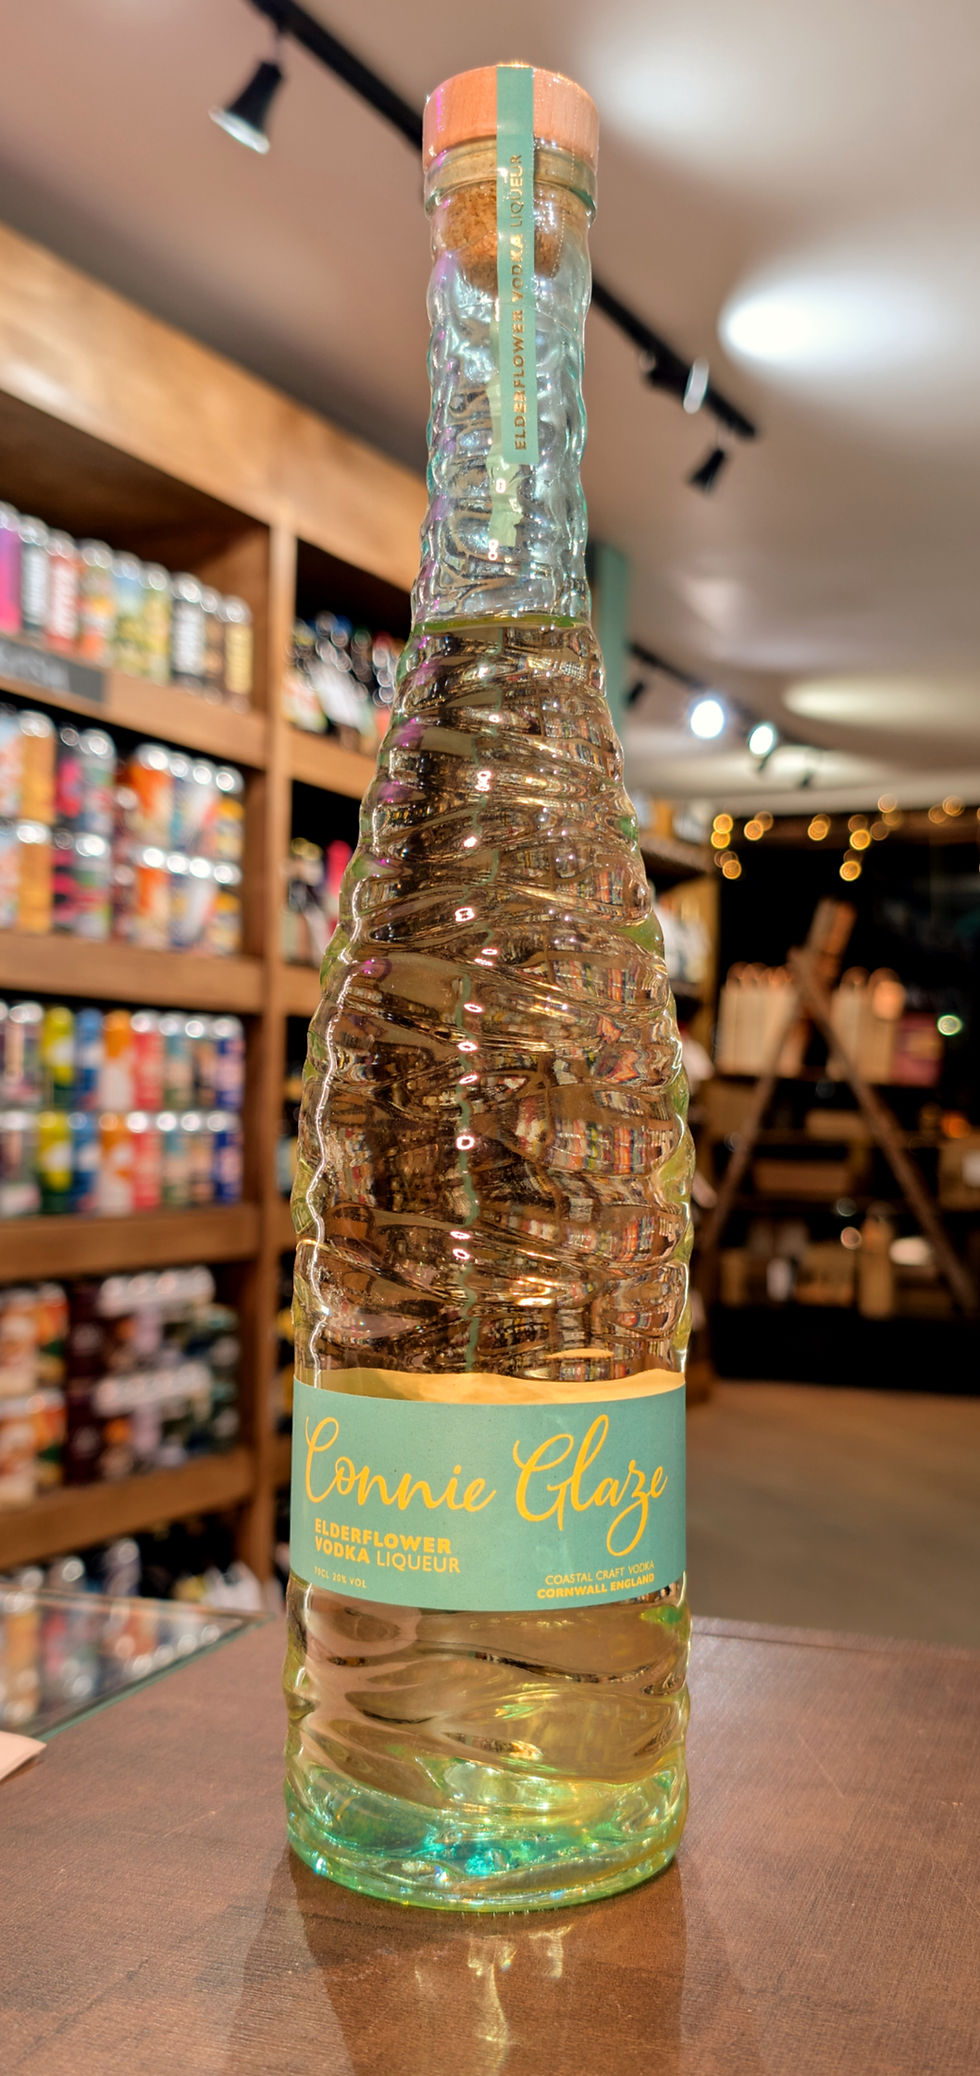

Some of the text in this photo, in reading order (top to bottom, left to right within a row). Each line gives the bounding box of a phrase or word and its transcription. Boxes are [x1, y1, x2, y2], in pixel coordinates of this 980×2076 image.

[509, 154, 527, 451] ELDERFLOWER VODKA LIQUEUR
[304, 1414, 668, 1557] Connie Glaze
[314, 1517, 452, 1554] ELDERFLOWER
[314, 1535, 461, 1573] VODKA LIQUEUR
[332, 1572, 347, 1585] 20%
[349, 1577, 368, 1589] VOL
[536, 1572, 655, 1599] CORNWALL ENGLAND
[544, 1560, 655, 1586] COASTAL CRAFT VODKA
